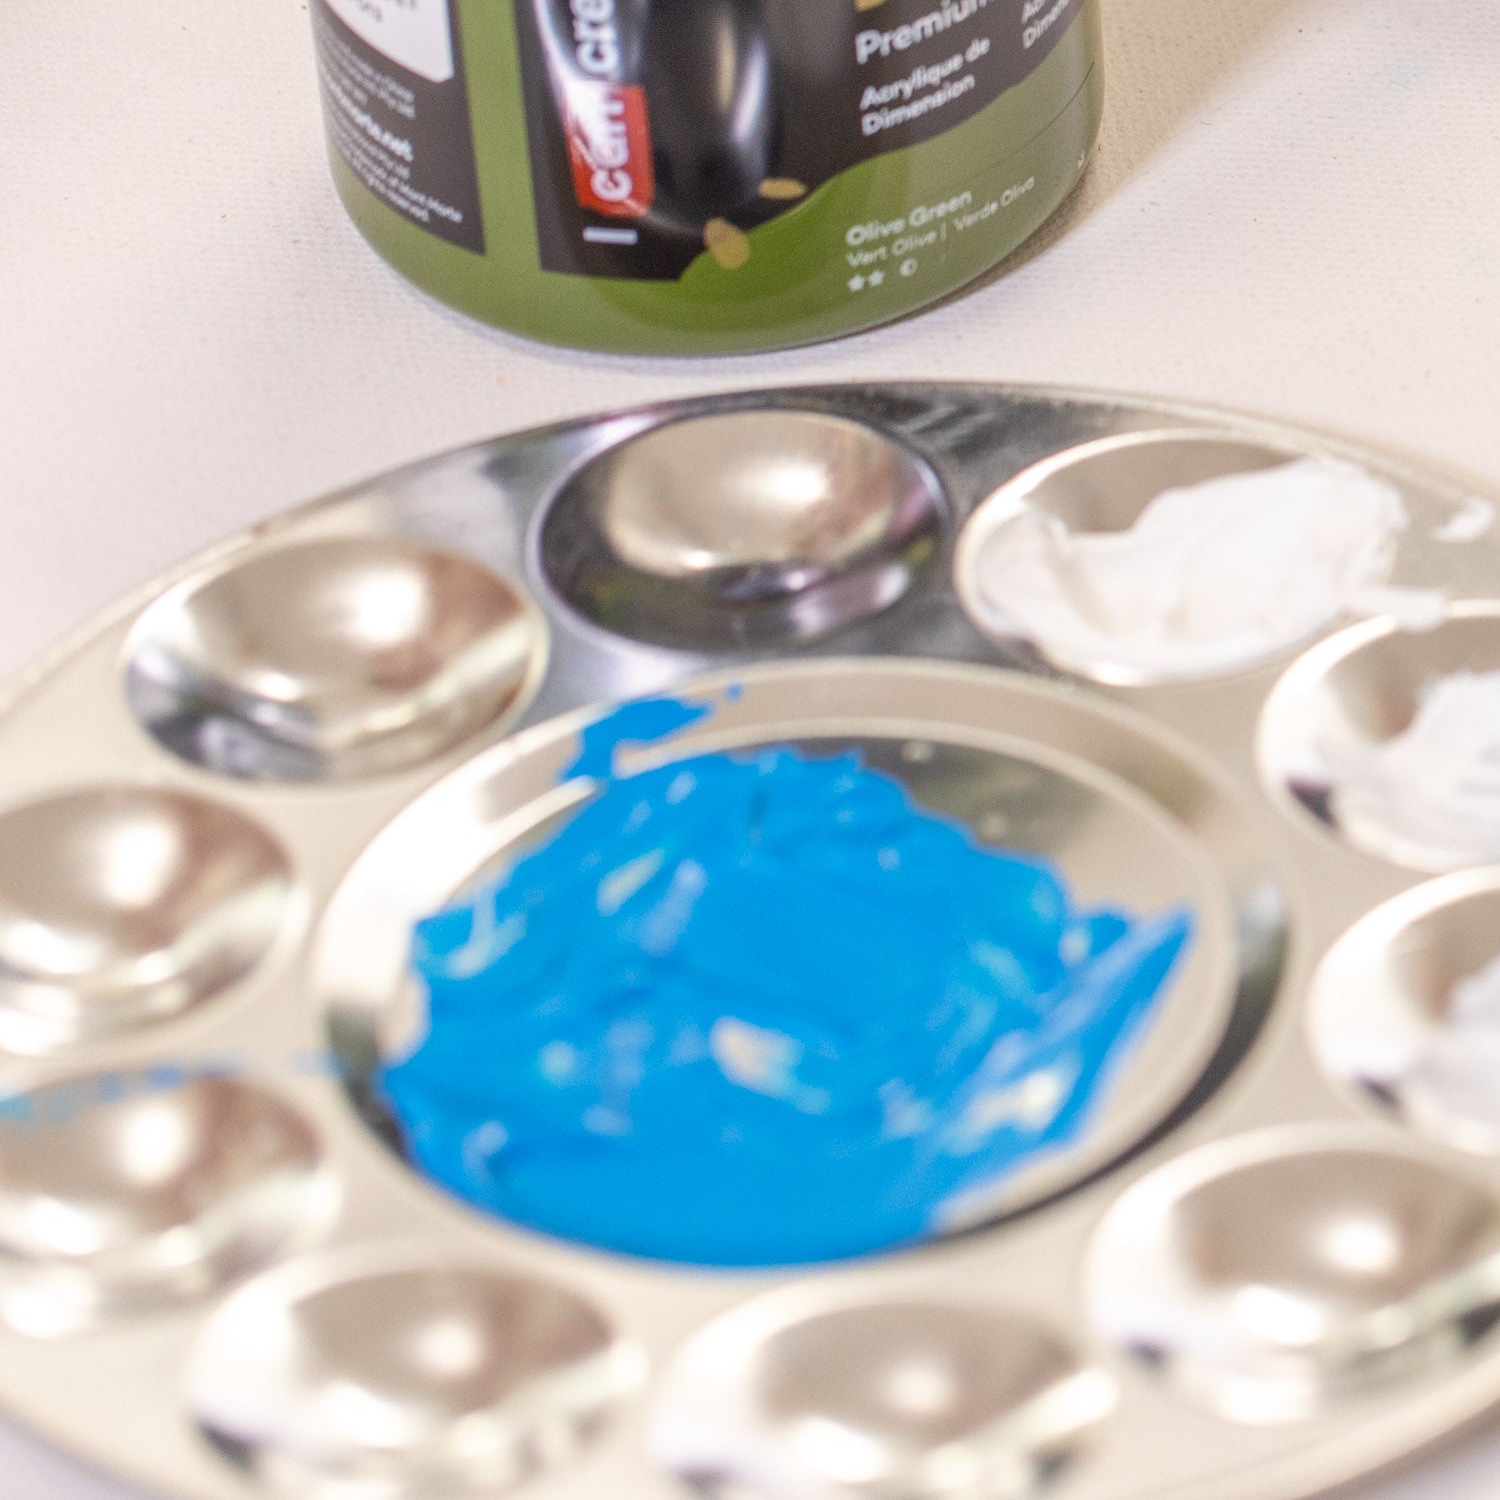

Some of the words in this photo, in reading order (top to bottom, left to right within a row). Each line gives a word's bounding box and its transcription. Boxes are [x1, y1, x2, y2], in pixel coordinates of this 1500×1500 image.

[859, 54, 964, 111] Acrylique
[964, 37, 991, 64] de
[861, 74, 976, 137] Dimension
[582, 225, 640, 247] I
[845, 217, 906, 247] Olive
[908, 190, 973, 228] Green
[846, 244, 888, 269] Vert
[891, 230, 939, 257] Olive
[952, 201, 999, 232] Verde
[1000, 175, 1036, 208] Oliva
